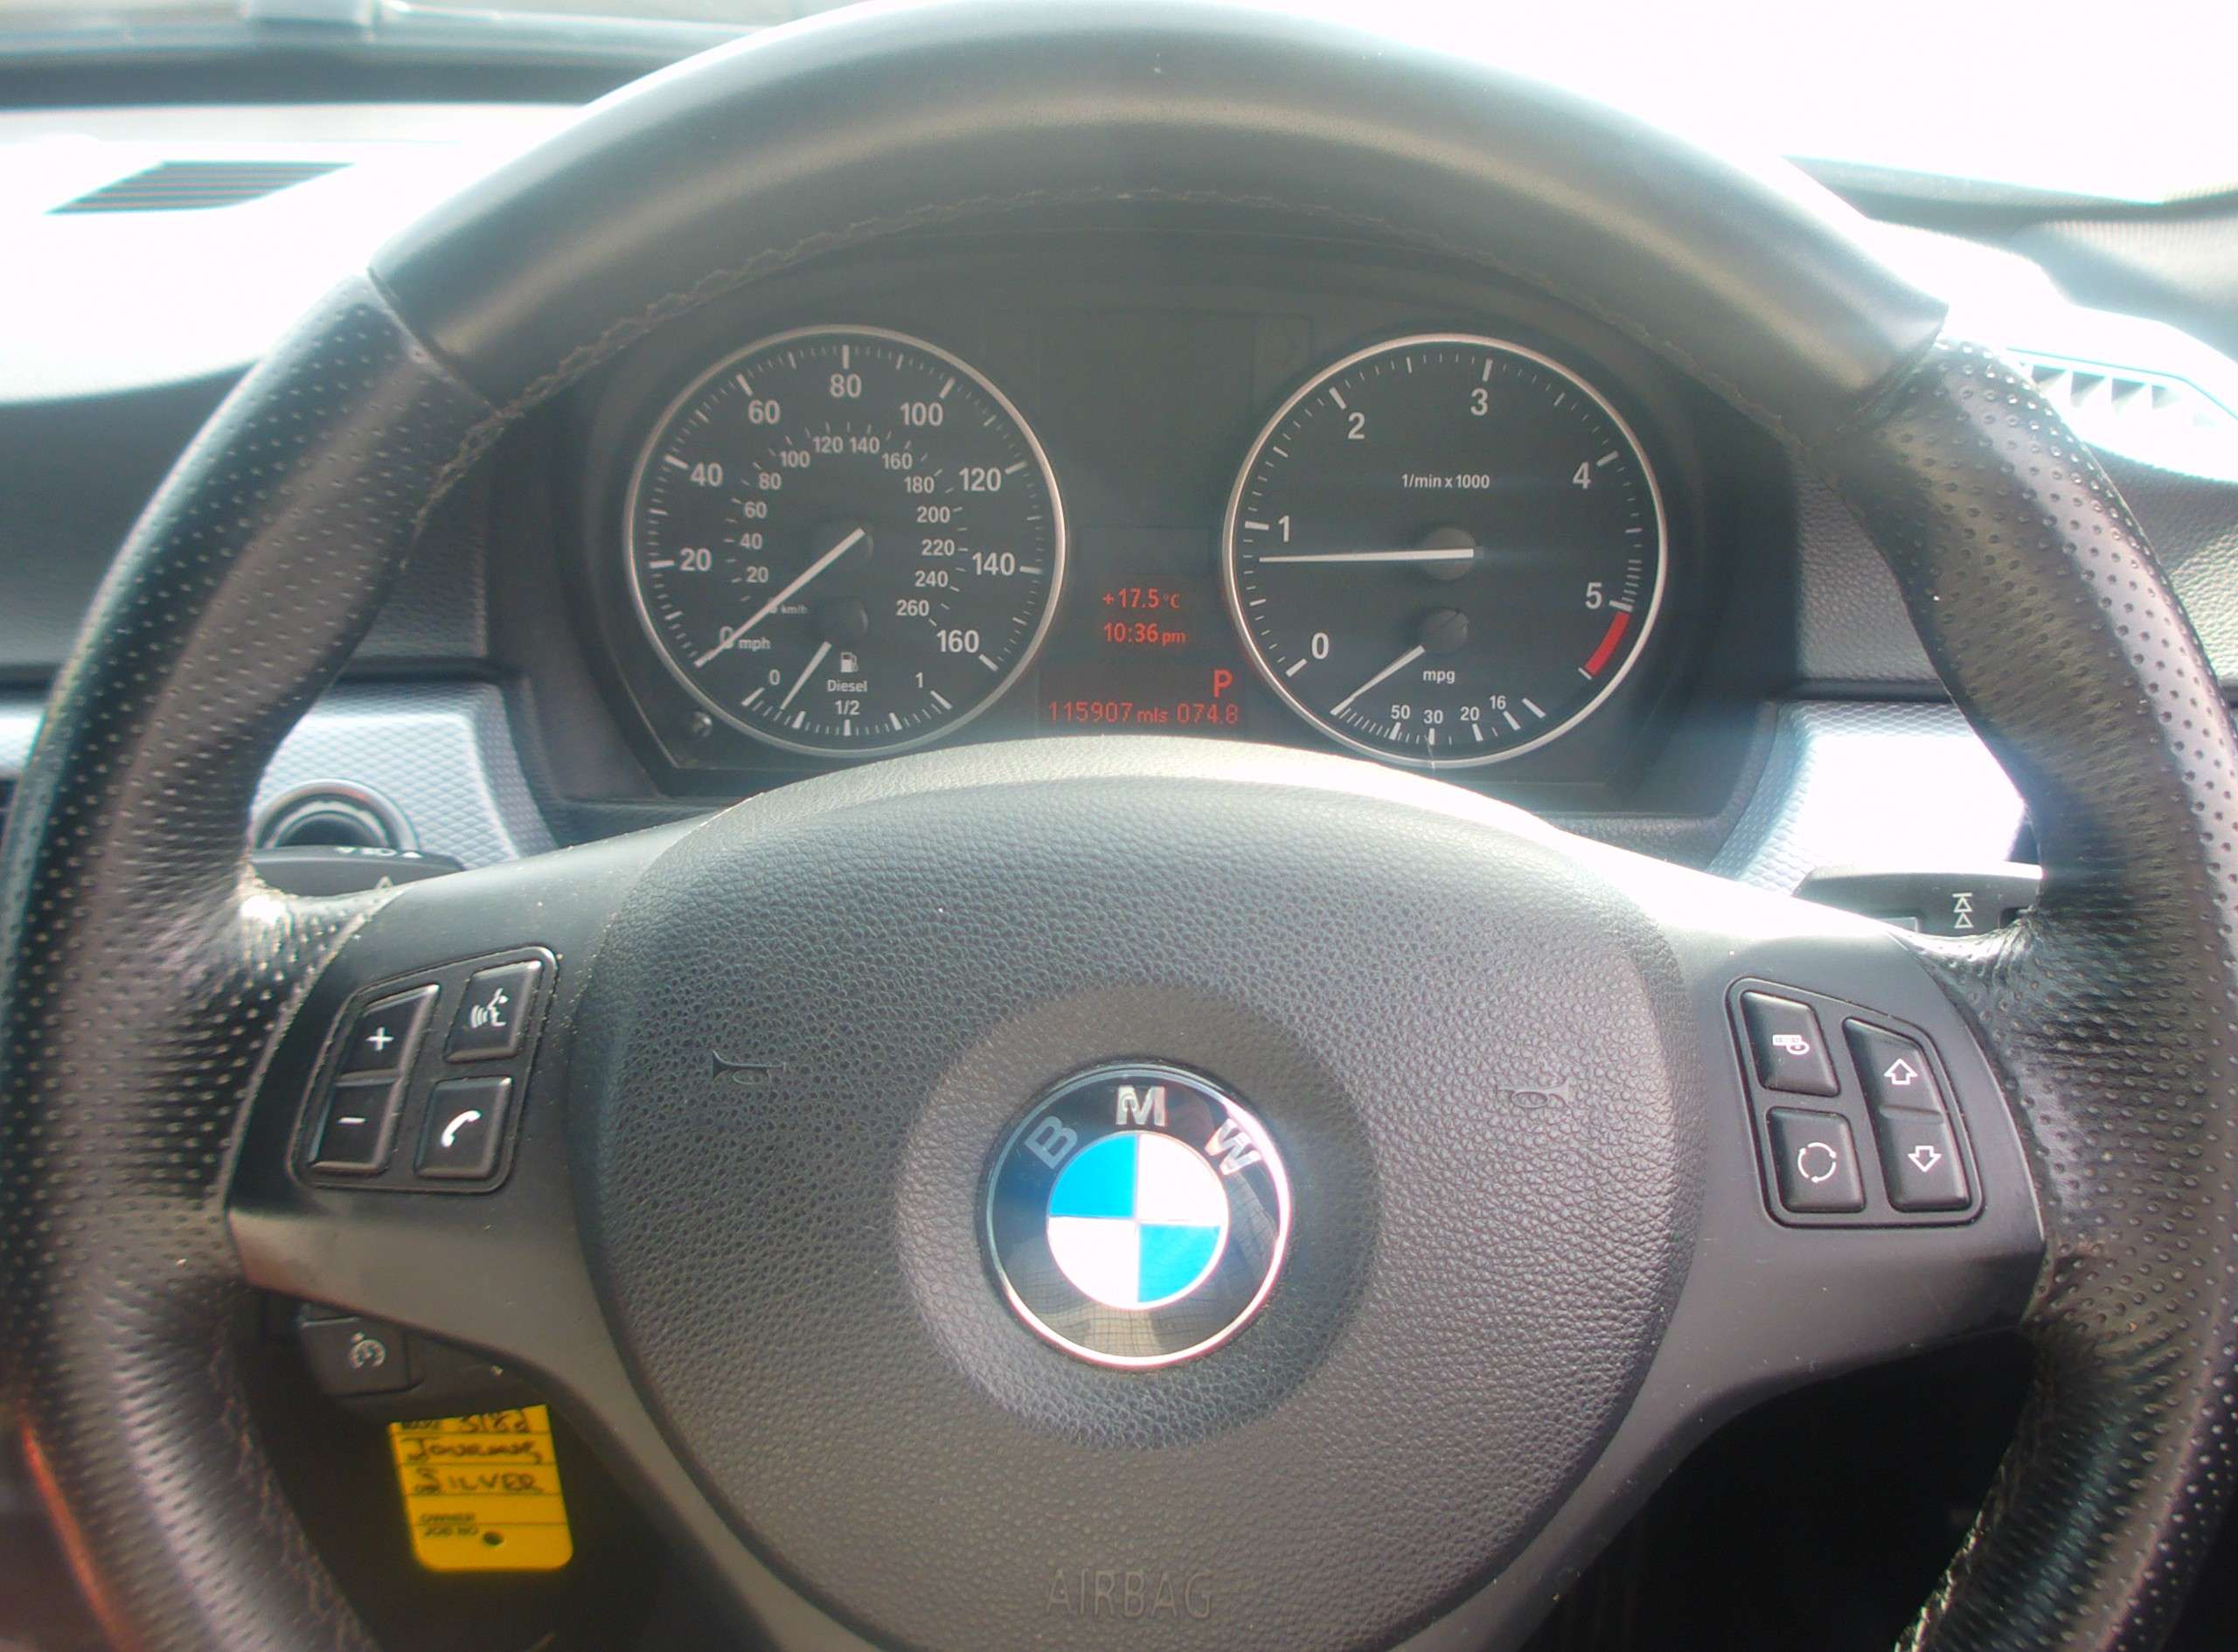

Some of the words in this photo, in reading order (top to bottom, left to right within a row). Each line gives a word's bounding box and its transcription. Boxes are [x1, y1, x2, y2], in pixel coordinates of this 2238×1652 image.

[831, 373, 862, 398] 80
[1470, 388, 1488, 416] 3
[748, 399, 781, 425] 60
[900, 402, 944, 427] 100
[1348, 412, 1366, 440] 2
[812, 436, 844, 454] 120
[849, 436, 880, 454] 140
[779, 450, 810, 468] 100
[882, 453, 913, 470] 160
[691, 462, 723, 486] 40
[759, 473, 782, 489] 80
[959, 468, 1002, 491] 120
[1401, 474, 1442, 489] 1/min
[1456, 474, 1491, 489] 1000
[1573, 462, 1591, 489] 4
[904, 476, 935, 494] 180
[744, 502, 767, 518] 60
[917, 506, 950, 524] 200
[1278, 515, 1289, 543] 1
[740, 533, 763, 550] 40
[921, 538, 956, 556] 220
[680, 548, 712, 572] 20
[971, 552, 1016, 576] 140
[747, 566, 769, 583] 20
[914, 571, 949, 587] 240
[1585, 582, 1602, 609] 5
[896, 600, 929, 616] 260
[936, 629, 979, 654] 160
[1104, 621, 1159, 643] 10:36
[1162, 630, 1186, 647] pm
[739, 637, 771, 650] mph
[1311, 632, 1330, 659] 0
[769, 670, 781, 685] 0
[827, 679, 867, 692] Diesel
[915, 671, 924, 688] 1
[1213, 670, 1234, 698] P
[1423, 670, 1456, 684] mpg
[835, 700, 860, 716] 1/2
[1490, 695, 1506, 710] 16
[1049, 701, 1134, 723] 115907
[1137, 706, 1169, 724] mls
[1391, 705, 1411, 719] 50
[1423, 709, 1442, 724] 30
[1460, 706, 1480, 721] 20
[1025, 1085, 1262, 1176] BMW
[1047, 1568, 1213, 1618] AIRBAG
